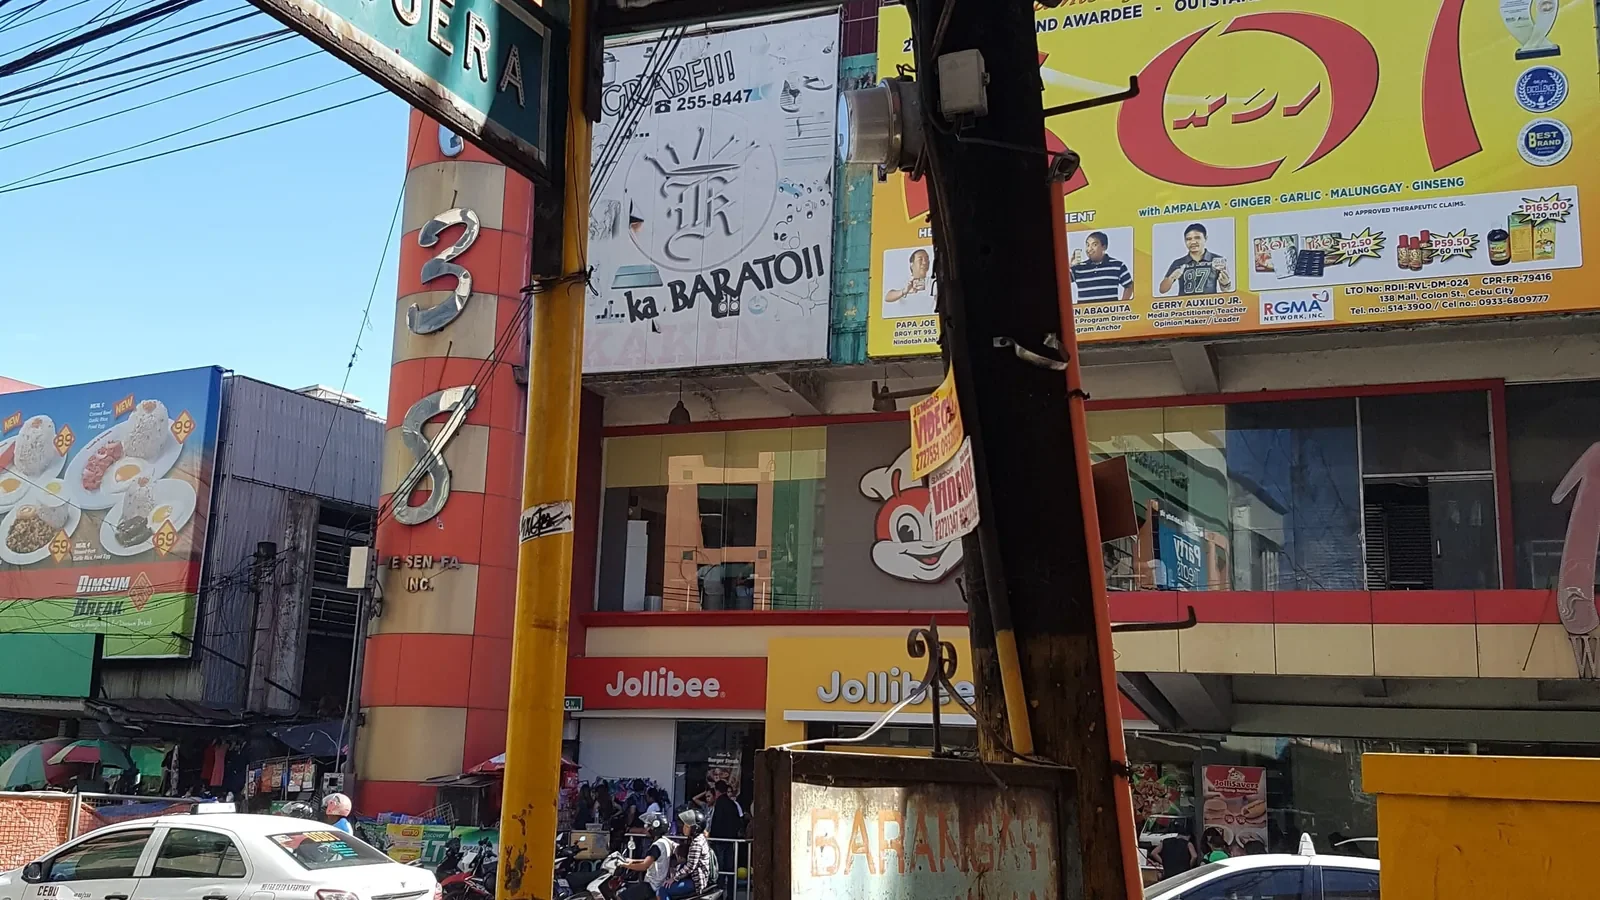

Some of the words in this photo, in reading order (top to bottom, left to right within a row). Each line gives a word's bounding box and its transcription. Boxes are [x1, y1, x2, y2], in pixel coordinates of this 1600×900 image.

[1062, 5, 1143, 29] AWARDEE
[676, 88, 753, 112] 255-8447
[1528, 131, 1559, 148] BEST
[1139, 206, 1161, 217] with
[1164, 200, 1221, 214] AMPALAYA
[1229, 195, 1271, 208] GINGER
[1280, 190, 1321, 203] GARLIC
[1330, 183, 1402, 199] MALUNGGAY
[1412, 177, 1464, 191] GINSENG
[1355, 207, 1391, 215] APPROVED
[1392, 203, 1437, 213] THERAPEUTIC
[1340, 238, 1372, 250] P12.50
[1434, 237, 1470, 248] P59.50
[1453, 246, 1464, 254] ml
[1347, 247, 1370, 256] LANG
[1184, 268, 1211, 294] 87
[1345, 286, 1364, 295] LTO
[1366, 285, 1382, 293] No:
[1482, 273, 1552, 285] CPR-FR-79416
[1380, 295, 1395, 303] 138
[1397, 294, 1419, 302] Mall,
[1421, 290, 1449, 300] Colon
[1468, 287, 1493, 297] Cebu
[1495, 286, 1515, 297] City
[1083, 304, 1131, 315] ABAQUITA
[1152, 301, 1183, 310] GERRY
[1185, 298, 1225, 308] AUXILIO
[1227, 296, 1242, 304] JR.
[1263, 299, 1323, 316] RGMA
[1350, 307, 1367, 315] Tel.
[1387, 302, 1432, 312] 514-3900
[1442, 300, 1457, 308] Cel
[1478, 294, 1549, 306] 0933-6809777
[1080, 316, 1110, 325] Program
[1111, 314, 1140, 322] Director
[1170, 309, 1216, 318] Practitioner,
[1217, 306, 1247, 314] Teacher
[1263, 313, 1307, 322] NETWORK,
[896, 320, 918, 329] PAPA
[919, 319, 936, 327] JOE
[1154, 320, 1183, 328] Opinion
[115, 395, 135, 417] NEW
[4, 411, 21, 432] NEW
[174, 420, 192, 435] 99
[56, 433, 74, 448] 89
[52, 539, 69, 555] 59
[156, 531, 175, 547] 69
[406, 554, 433, 569] SEN
[440, 555, 460, 569] FA
[76, 574, 132, 593] DIMSUM
[73, 596, 125, 617] BREAK
[605, 666, 721, 698] Jollibee
[810, 807, 1043, 878] BARANGAY
[37, 885, 60, 897] CEBU
